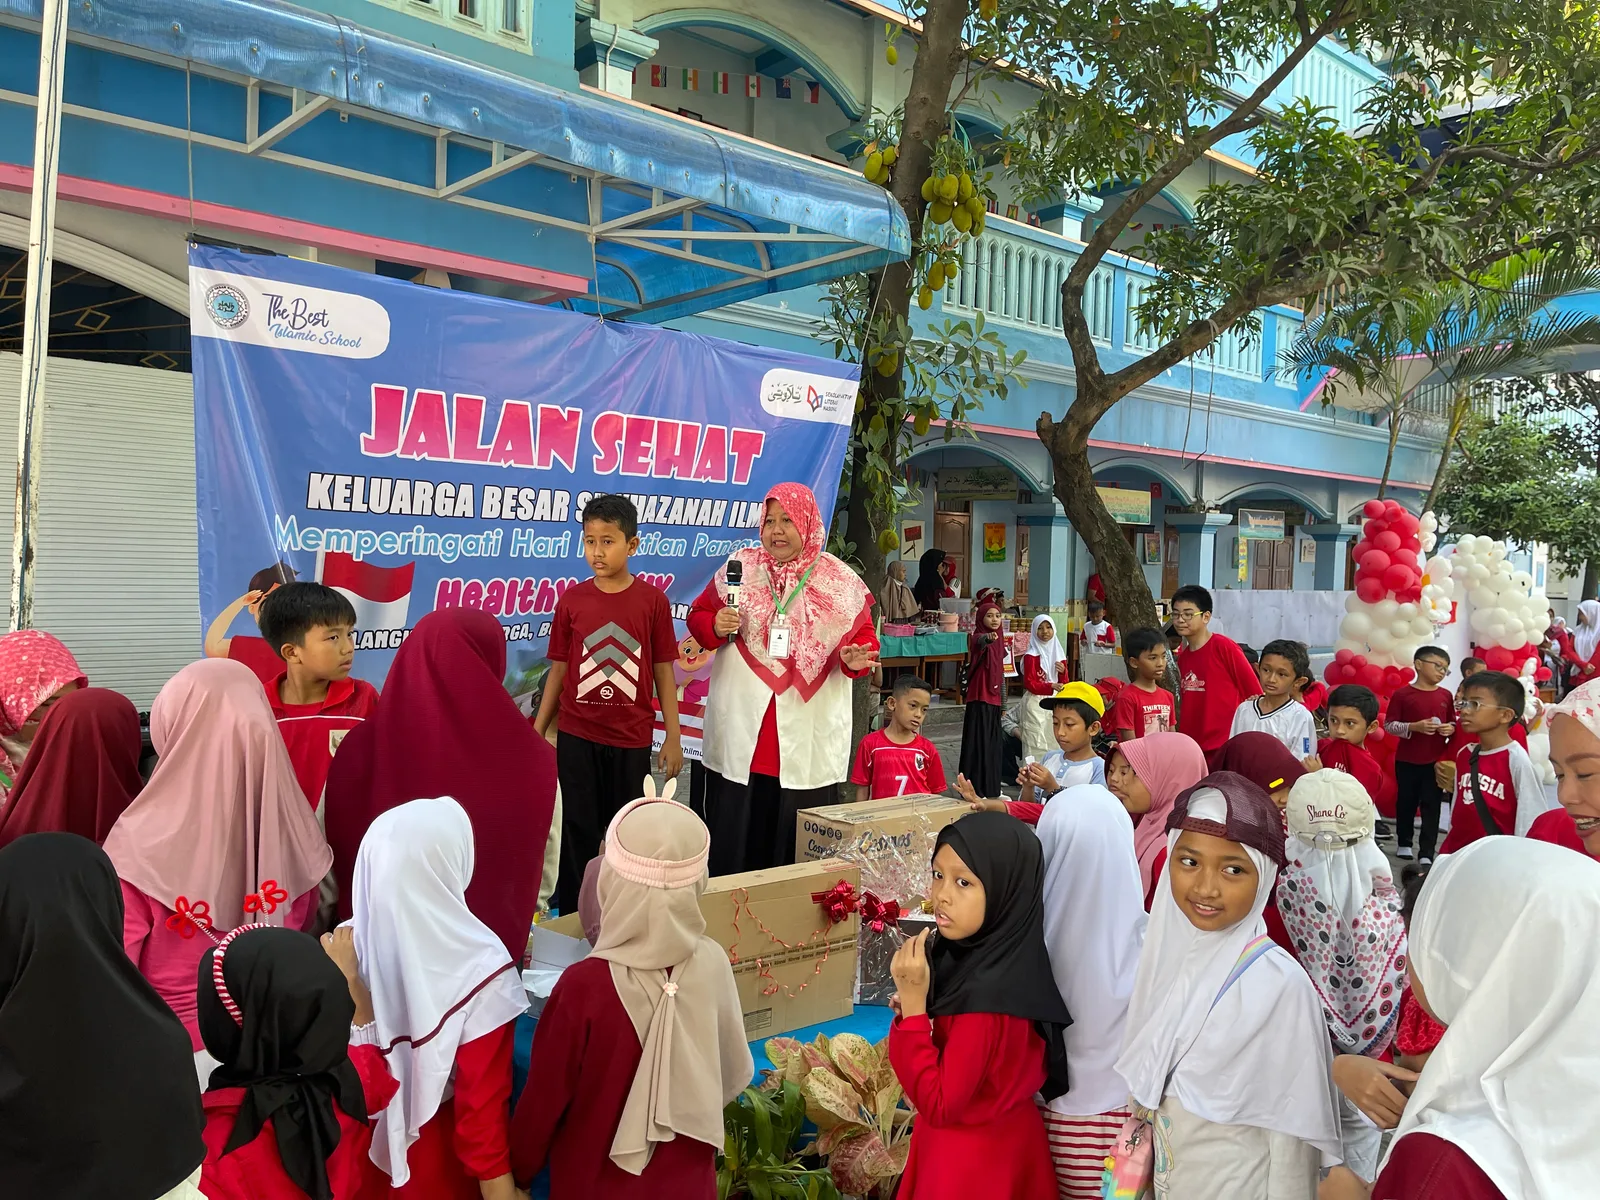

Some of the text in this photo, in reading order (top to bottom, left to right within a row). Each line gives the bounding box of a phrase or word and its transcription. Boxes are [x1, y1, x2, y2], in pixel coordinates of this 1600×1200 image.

[262, 293, 289, 327] The
[288, 298, 330, 330] Best
[269, 324, 362, 348] Islamic School
[360, 383, 765, 485] JALAN SEHAT
[307, 472, 474, 518] KELUARGA
[481, 486, 570, 522] BESAR
[275, 513, 503, 563] Memperingati
[509, 527, 571, 558] Hari
[895, 775, 908, 797] 7
[1306, 804, 1333, 821] Shane
